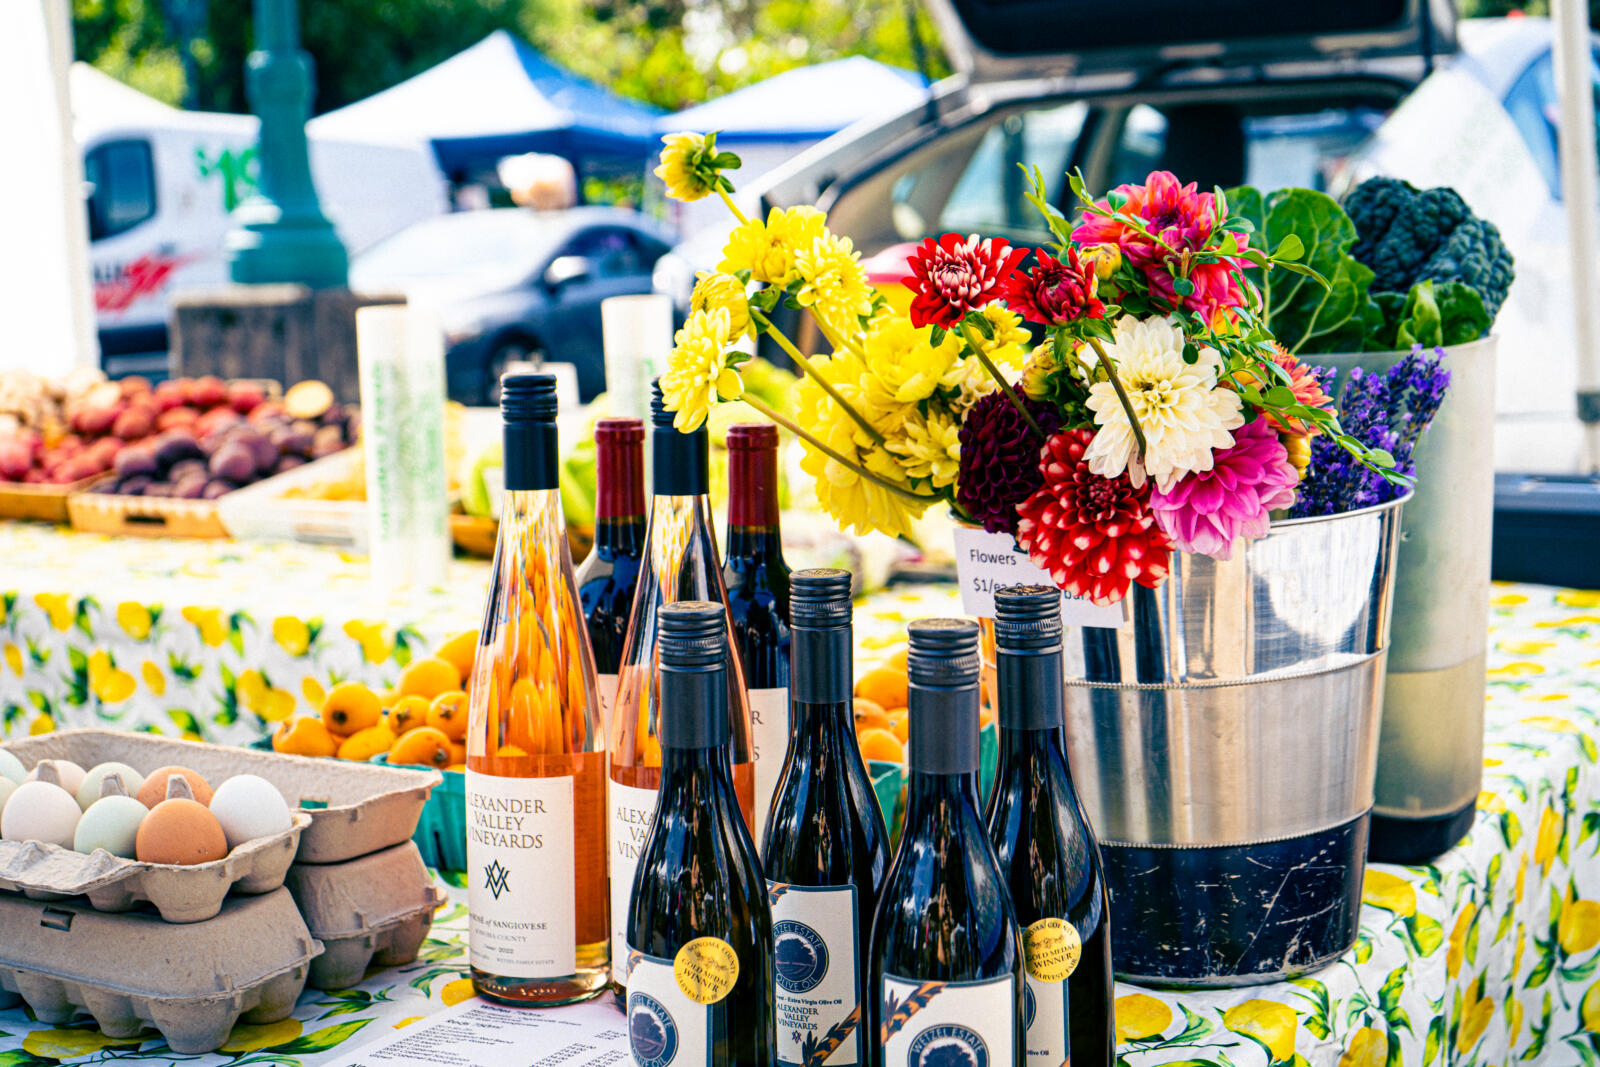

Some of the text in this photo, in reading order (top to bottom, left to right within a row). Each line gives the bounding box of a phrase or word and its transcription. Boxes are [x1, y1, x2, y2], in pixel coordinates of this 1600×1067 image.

[969, 549, 1017, 566] Flowers
[470, 791, 548, 814] LEXANDER
[474, 810, 525, 831] VALLEY
[616, 807, 656, 826] ALEXA
[471, 826, 544, 849] INEYARDS
[492, 919, 548, 931] SANGIOVESE
[497, 933, 528, 943] COUNTY
[793, 924, 824, 950] ESTATE
[1049, 943, 1075, 956] MEDAL
[1033, 952, 1073, 969] WINNER
[681, 958, 729, 987] GOLD MEDAL
[683, 967, 720, 993] WINNER
[776, 973, 818, 992] OLIVE OIL
[776, 1003, 819, 1016] ALEXANDER
[784, 1012, 810, 1023] VALLEY
[777, 1018, 818, 1031] VINEYARDS
[910, 1027, 986, 1054] WETZEL ESTATE
[1026, 1048, 1039, 1056] live
